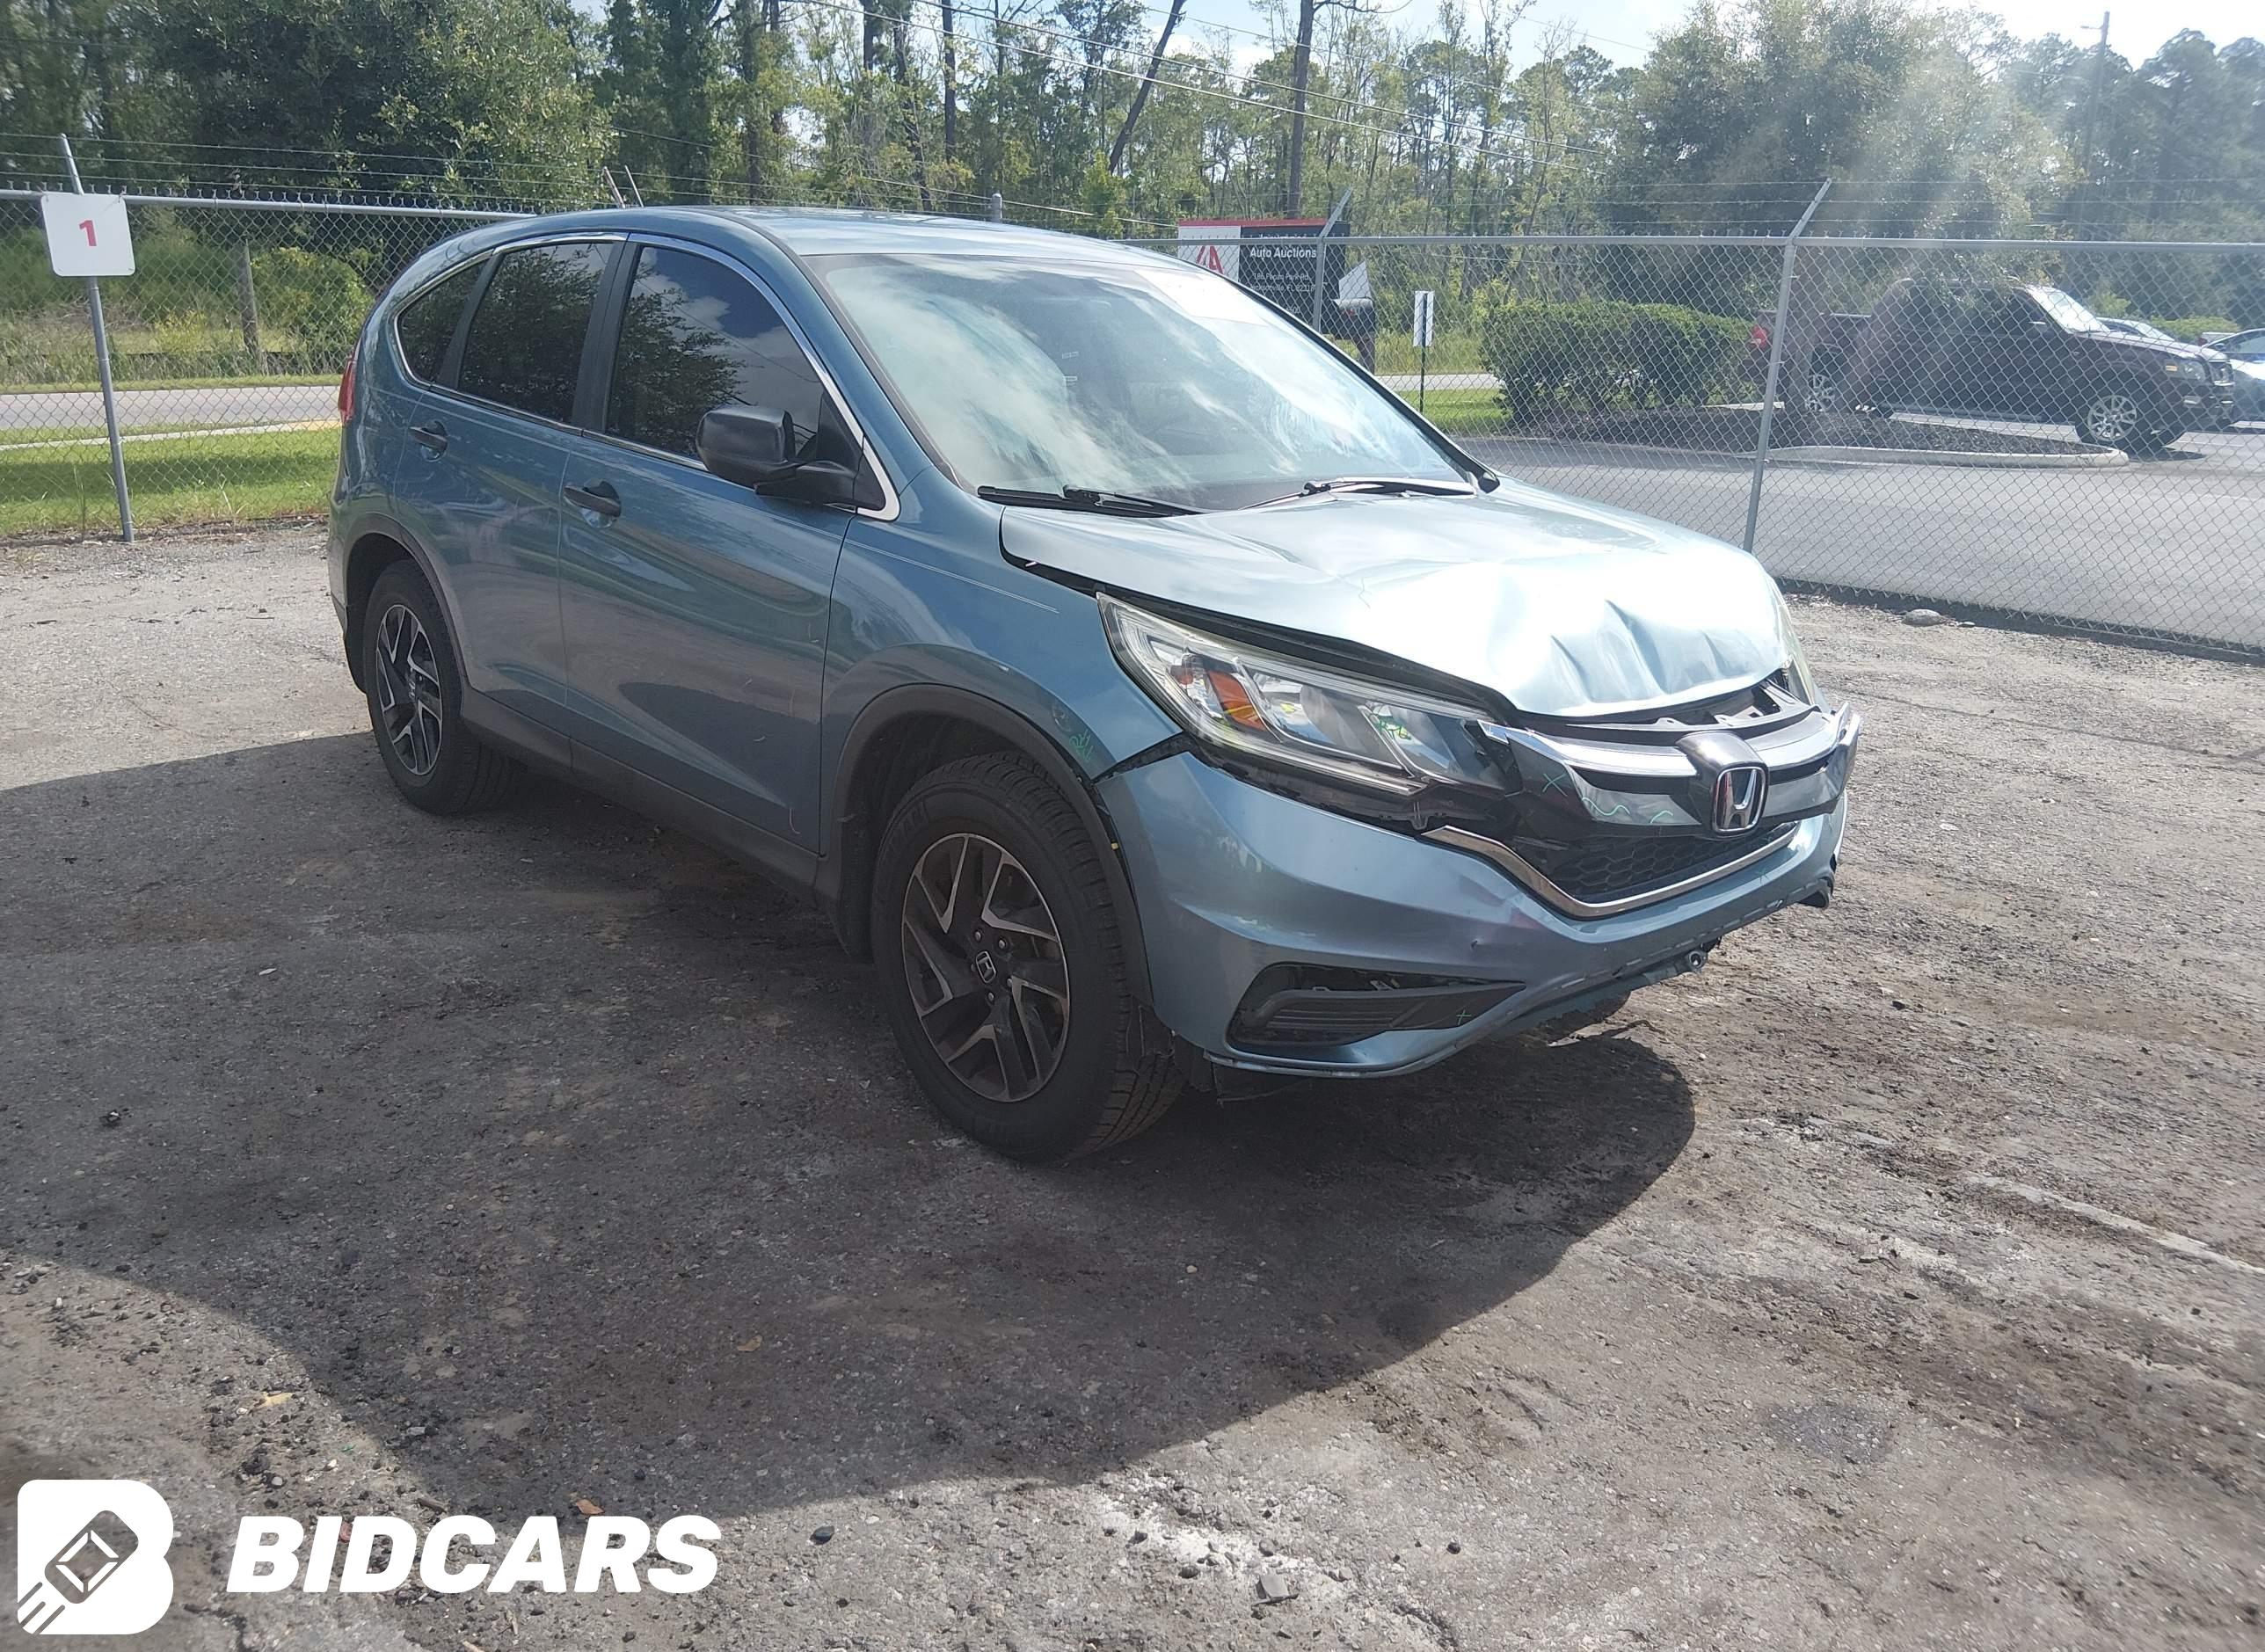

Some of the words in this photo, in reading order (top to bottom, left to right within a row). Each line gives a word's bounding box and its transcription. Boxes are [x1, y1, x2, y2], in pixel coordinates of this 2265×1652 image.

[79, 220, 97, 247] 1
[1249, 247, 1271, 258] Auto
[1273, 246, 1317, 258] Auctions
